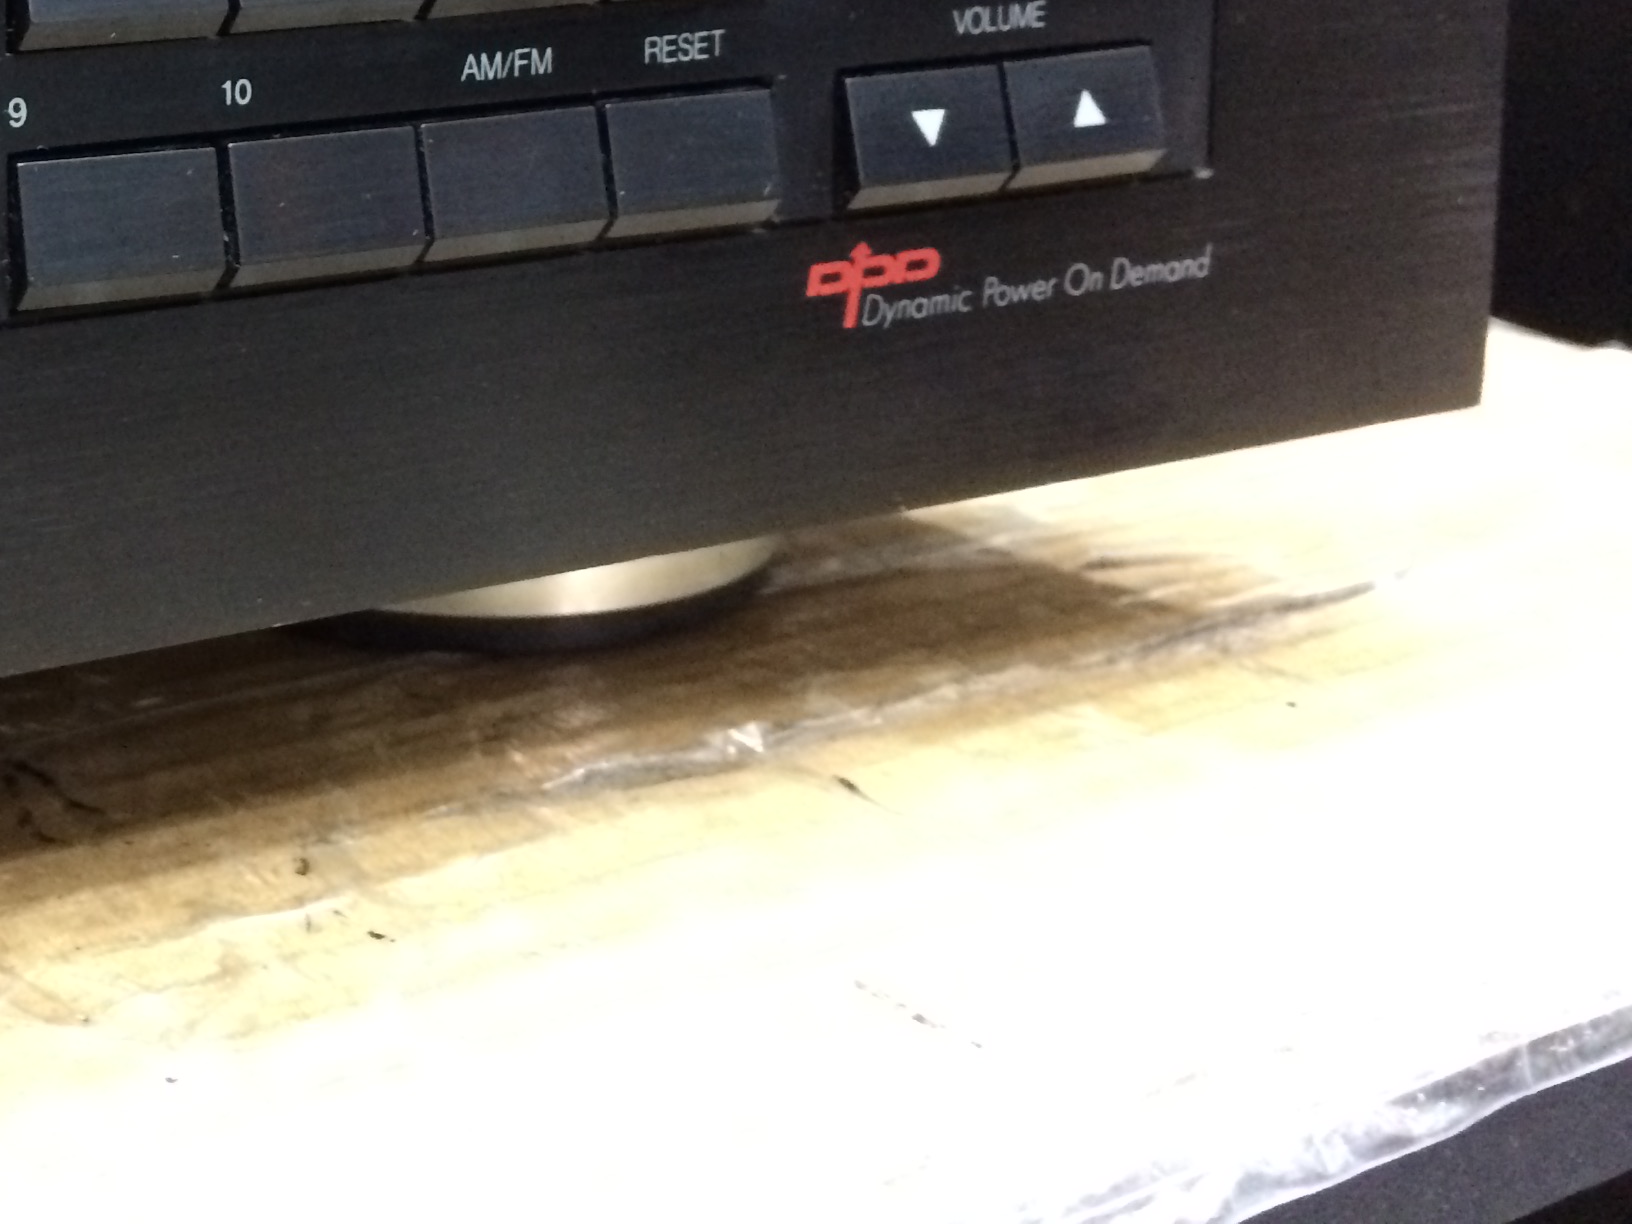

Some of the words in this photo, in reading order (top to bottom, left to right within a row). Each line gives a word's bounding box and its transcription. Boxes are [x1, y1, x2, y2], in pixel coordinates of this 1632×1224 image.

[953, 0, 1046, 35] VOLUME
[644, 29, 725, 64] RESET
[460, 47, 553, 82] AM/FM
[221, 78, 252, 106] 10
[7, 97, 28, 128] 9
[861, 284, 974, 329] Dynamic
[982, 276, 1058, 309] Power
[1064, 262, 1104, 296] On
[1110, 241, 1213, 290] Demand
